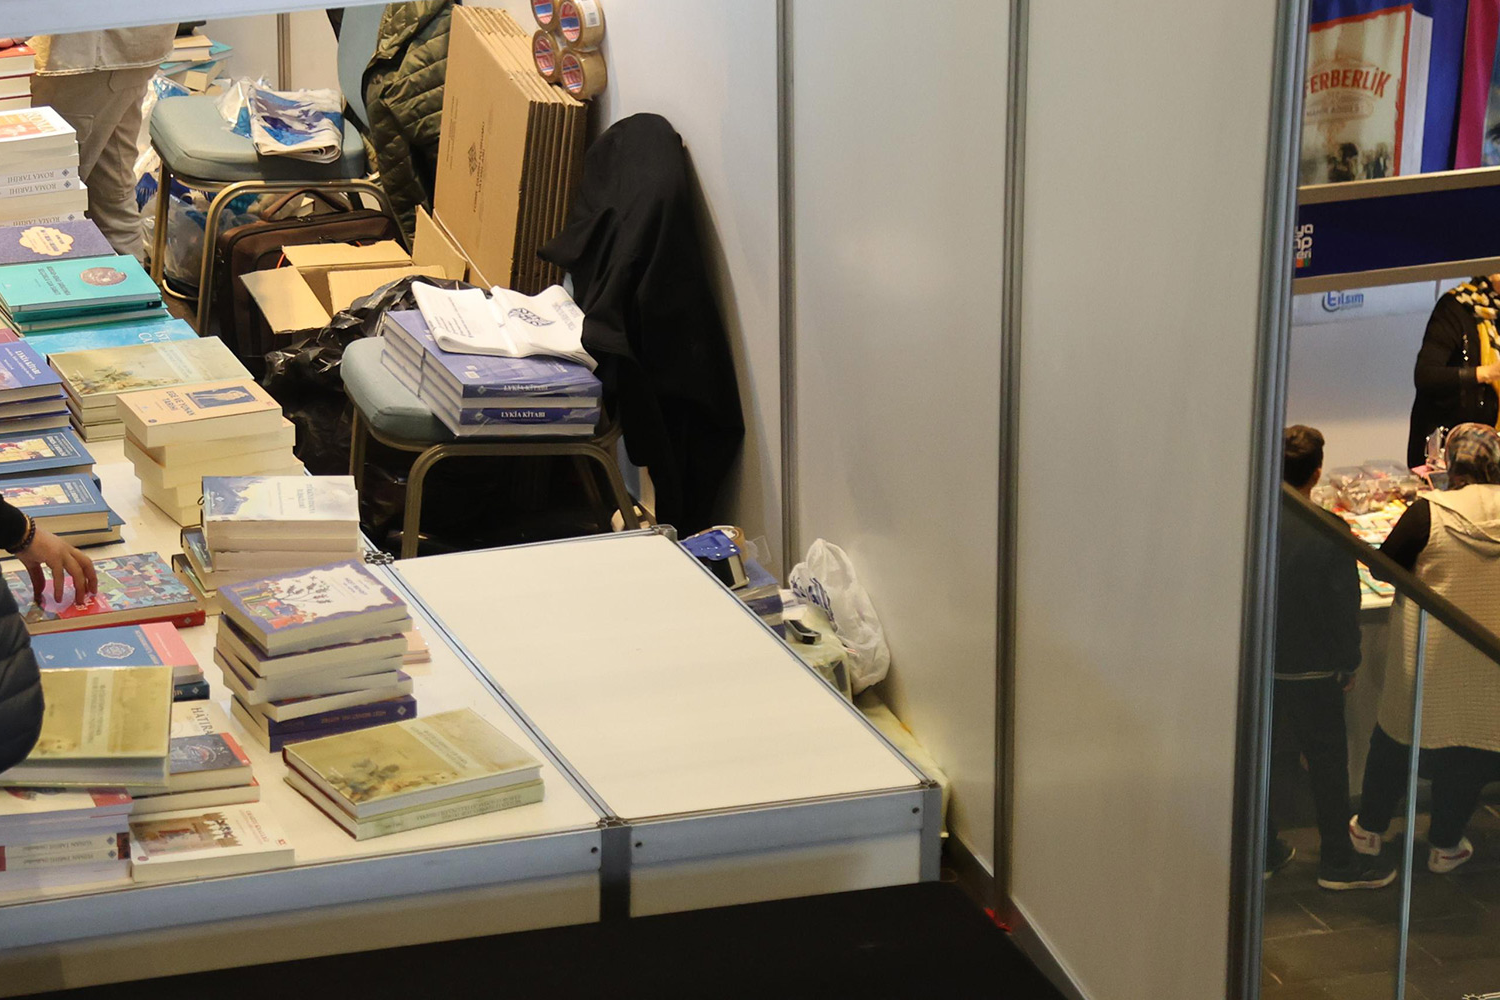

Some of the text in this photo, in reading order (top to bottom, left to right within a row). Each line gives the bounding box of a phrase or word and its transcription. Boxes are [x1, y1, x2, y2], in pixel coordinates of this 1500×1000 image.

[1306, 67, 1391, 98] ERBERLİK
[31, 170, 55, 181] ROMA
[33, 181, 57, 192] ROMA
[501, 410, 546, 419] LYKİA KİTABI
